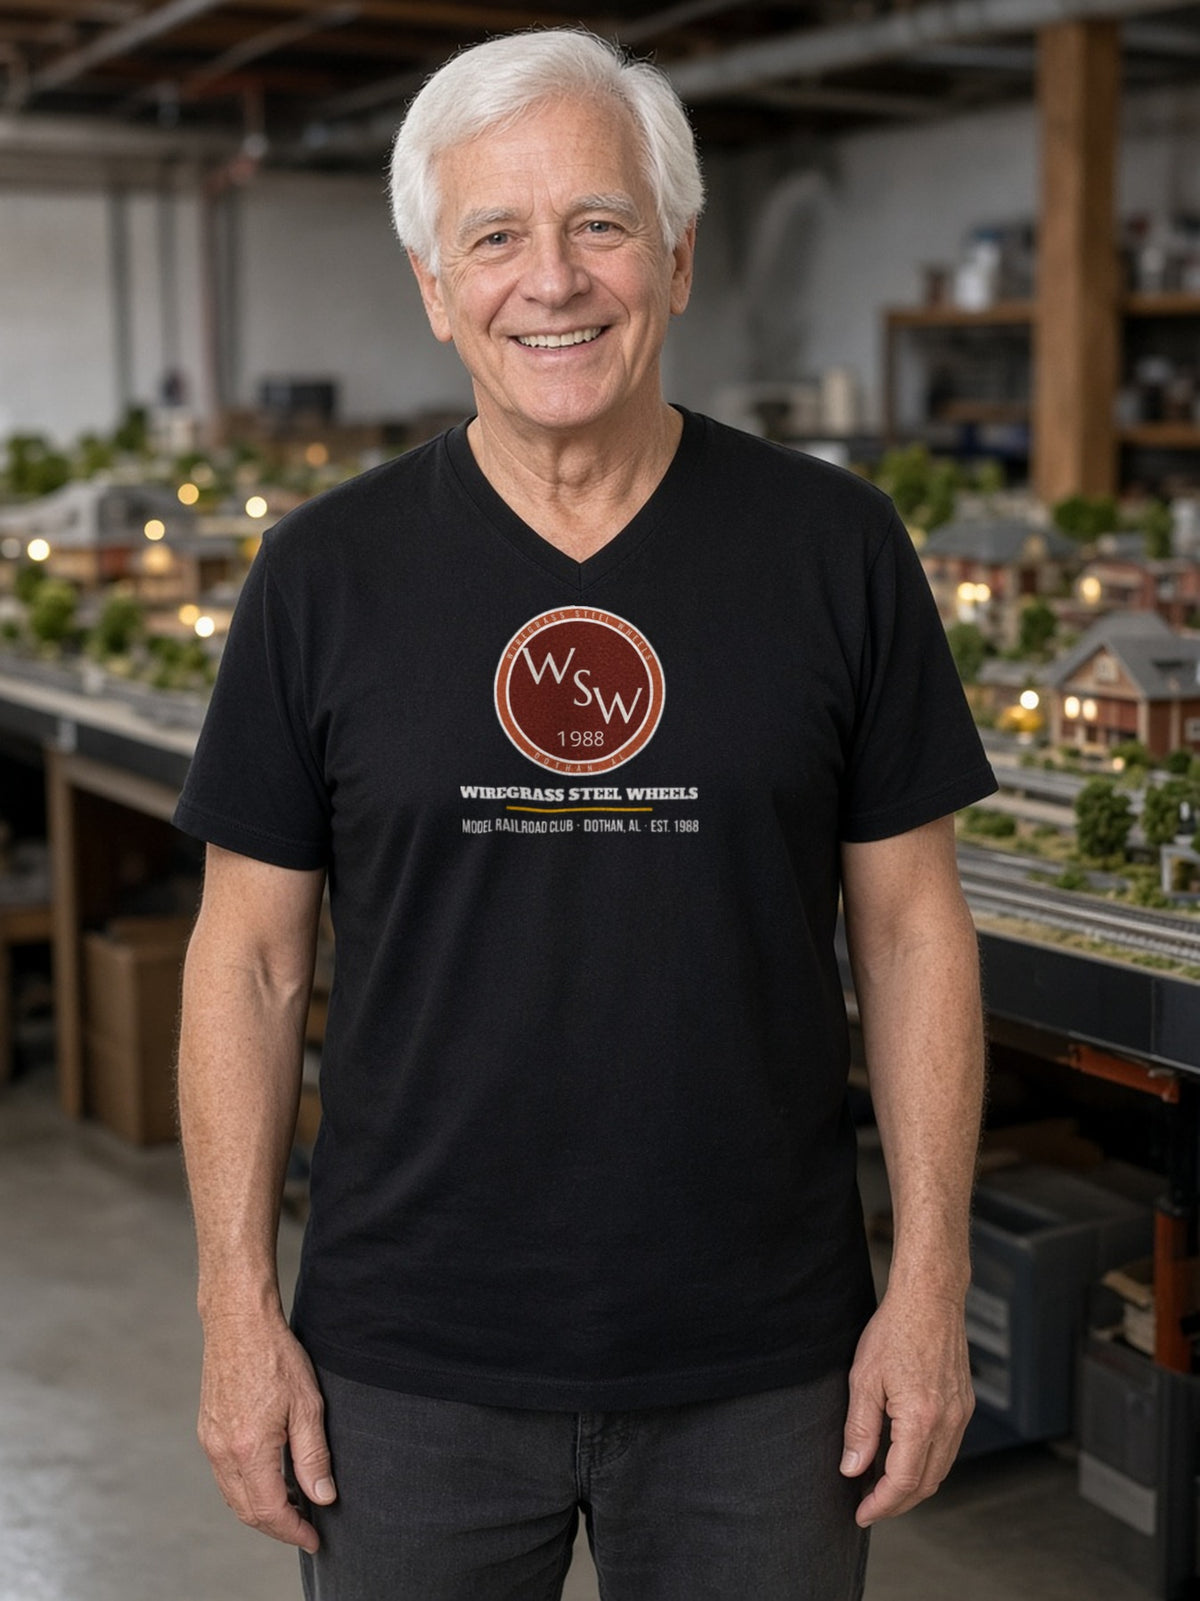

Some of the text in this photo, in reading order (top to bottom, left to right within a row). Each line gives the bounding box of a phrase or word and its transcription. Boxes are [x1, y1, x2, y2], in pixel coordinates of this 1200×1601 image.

[506, 610, 653, 661] WIREGRASS STEEL WHEELS
[557, 730, 605, 747] 1988
[611, 754, 625, 765] AL
[460, 786, 699, 802] WIREGRASS STEEL WHEELS
[462, 818, 699, 834] MODEL RAILROAD CLUB DOTHAN, AL EST. 1988
